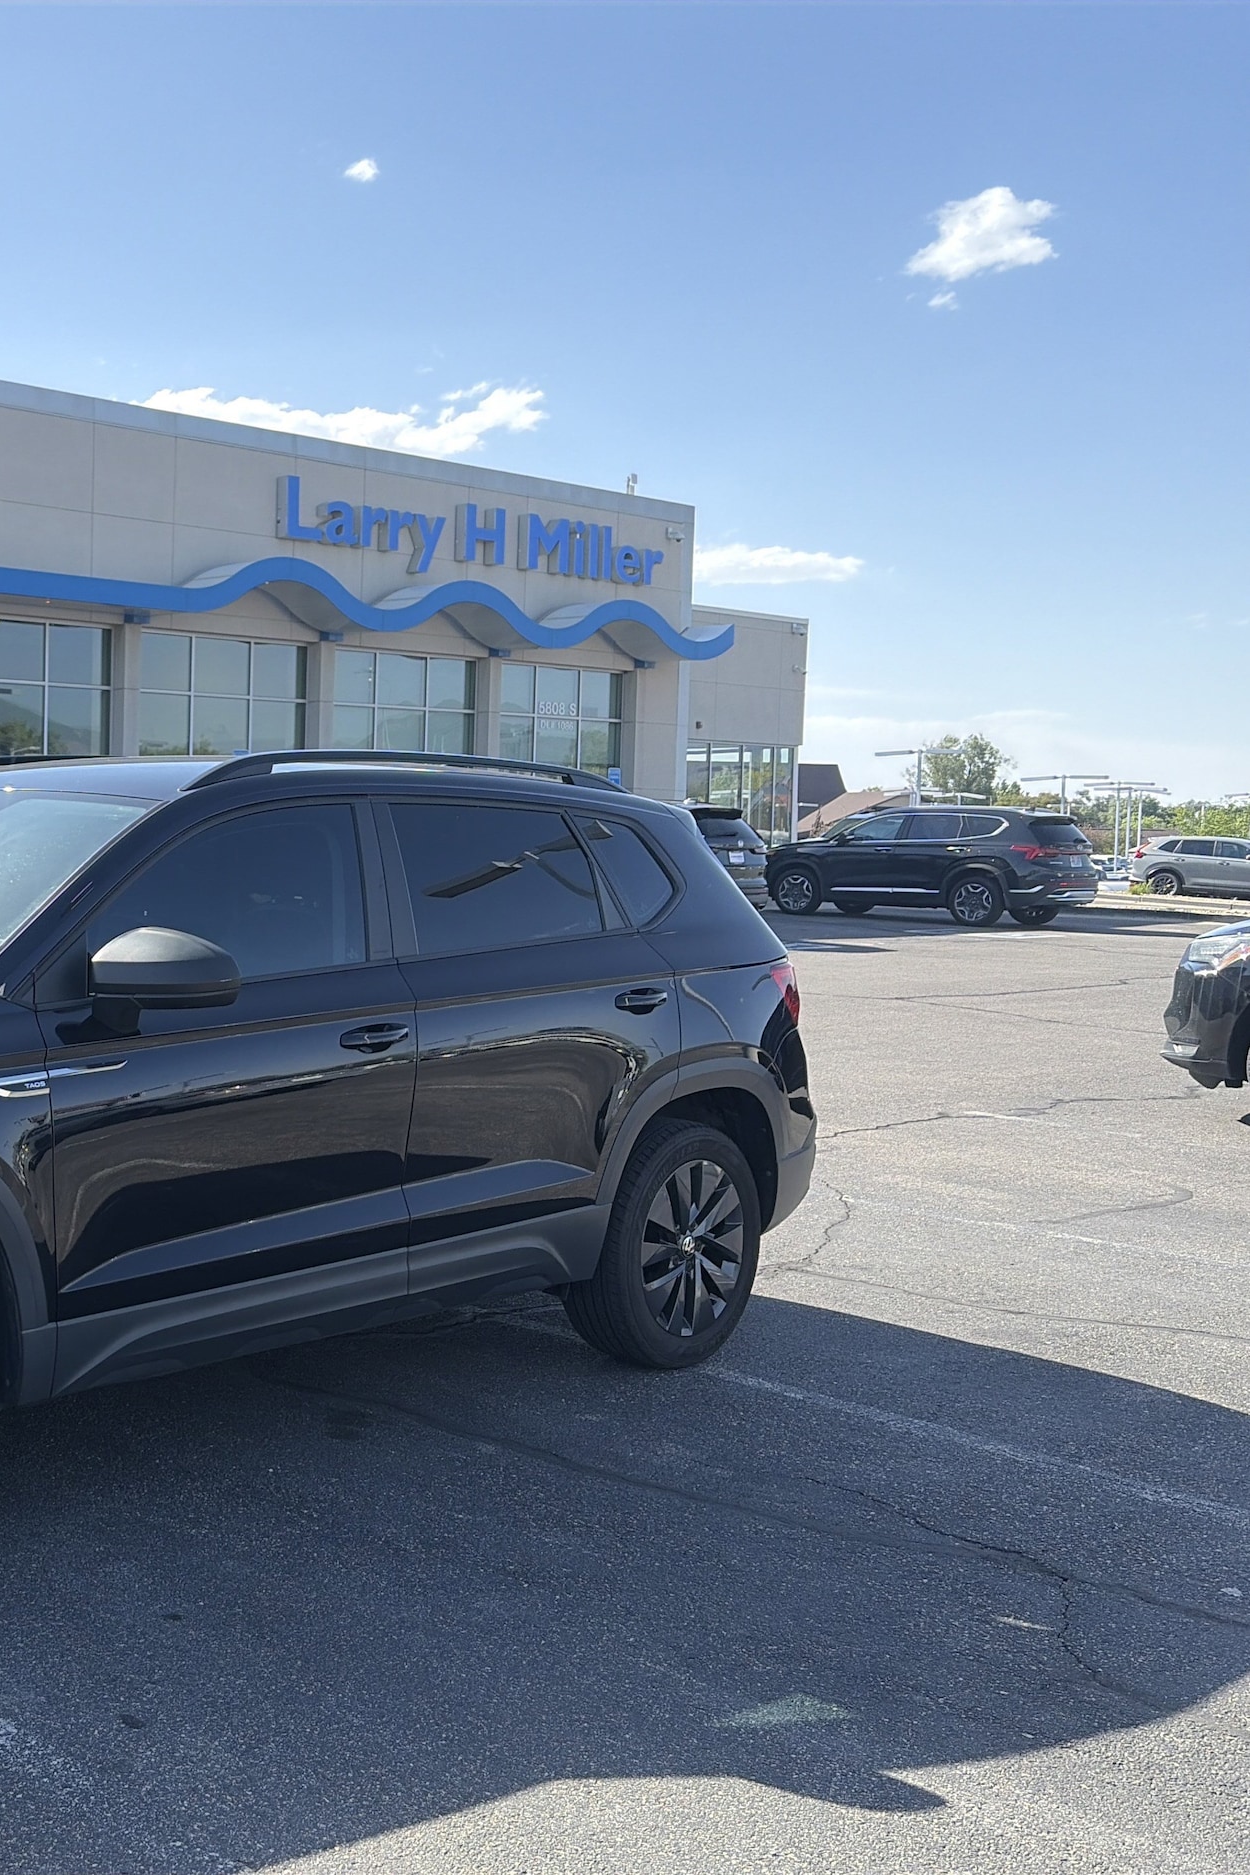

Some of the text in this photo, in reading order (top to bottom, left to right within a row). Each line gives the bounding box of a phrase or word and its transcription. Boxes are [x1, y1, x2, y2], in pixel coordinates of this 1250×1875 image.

[276, 475, 664, 586] Larry H Miller
[539, 701, 577, 716] 5808 S
[24, 1080, 46, 1089] TAOS
